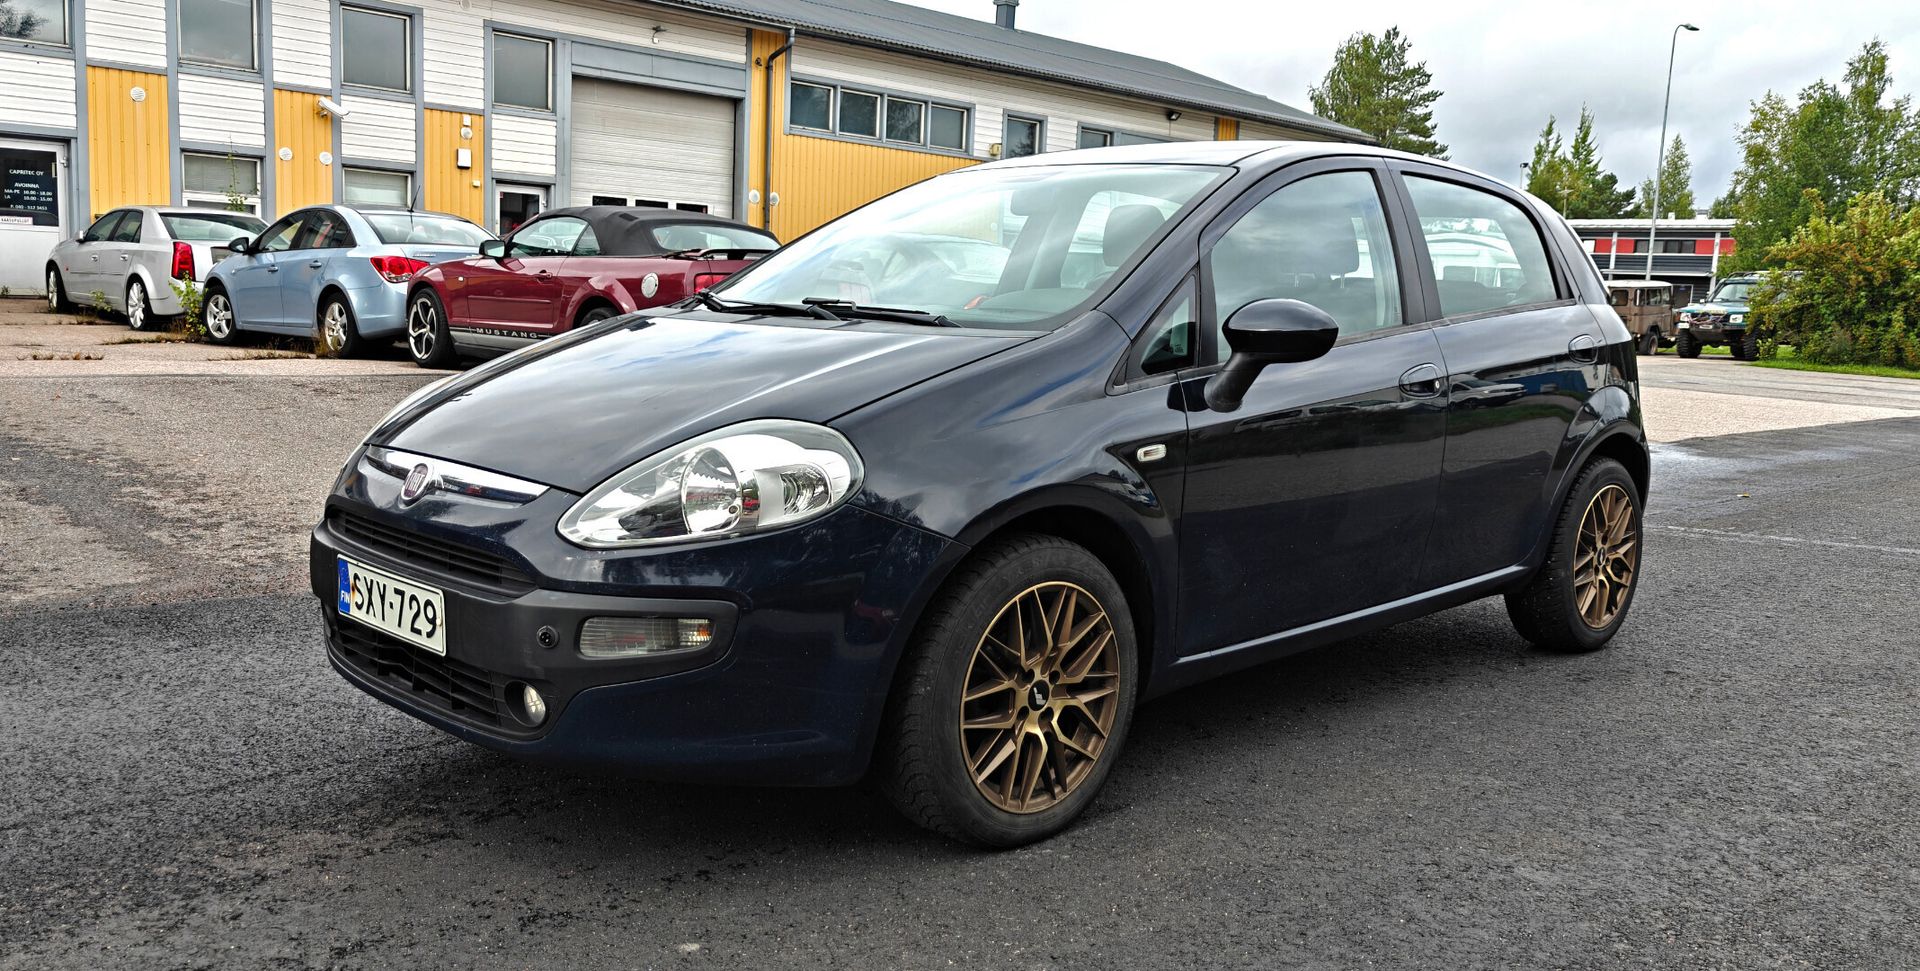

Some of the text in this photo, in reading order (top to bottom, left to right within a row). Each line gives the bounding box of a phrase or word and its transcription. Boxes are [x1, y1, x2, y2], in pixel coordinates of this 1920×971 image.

[476, 328, 538, 338] MUSTANG
[341, 572, 437, 638] FIN SXY-729
